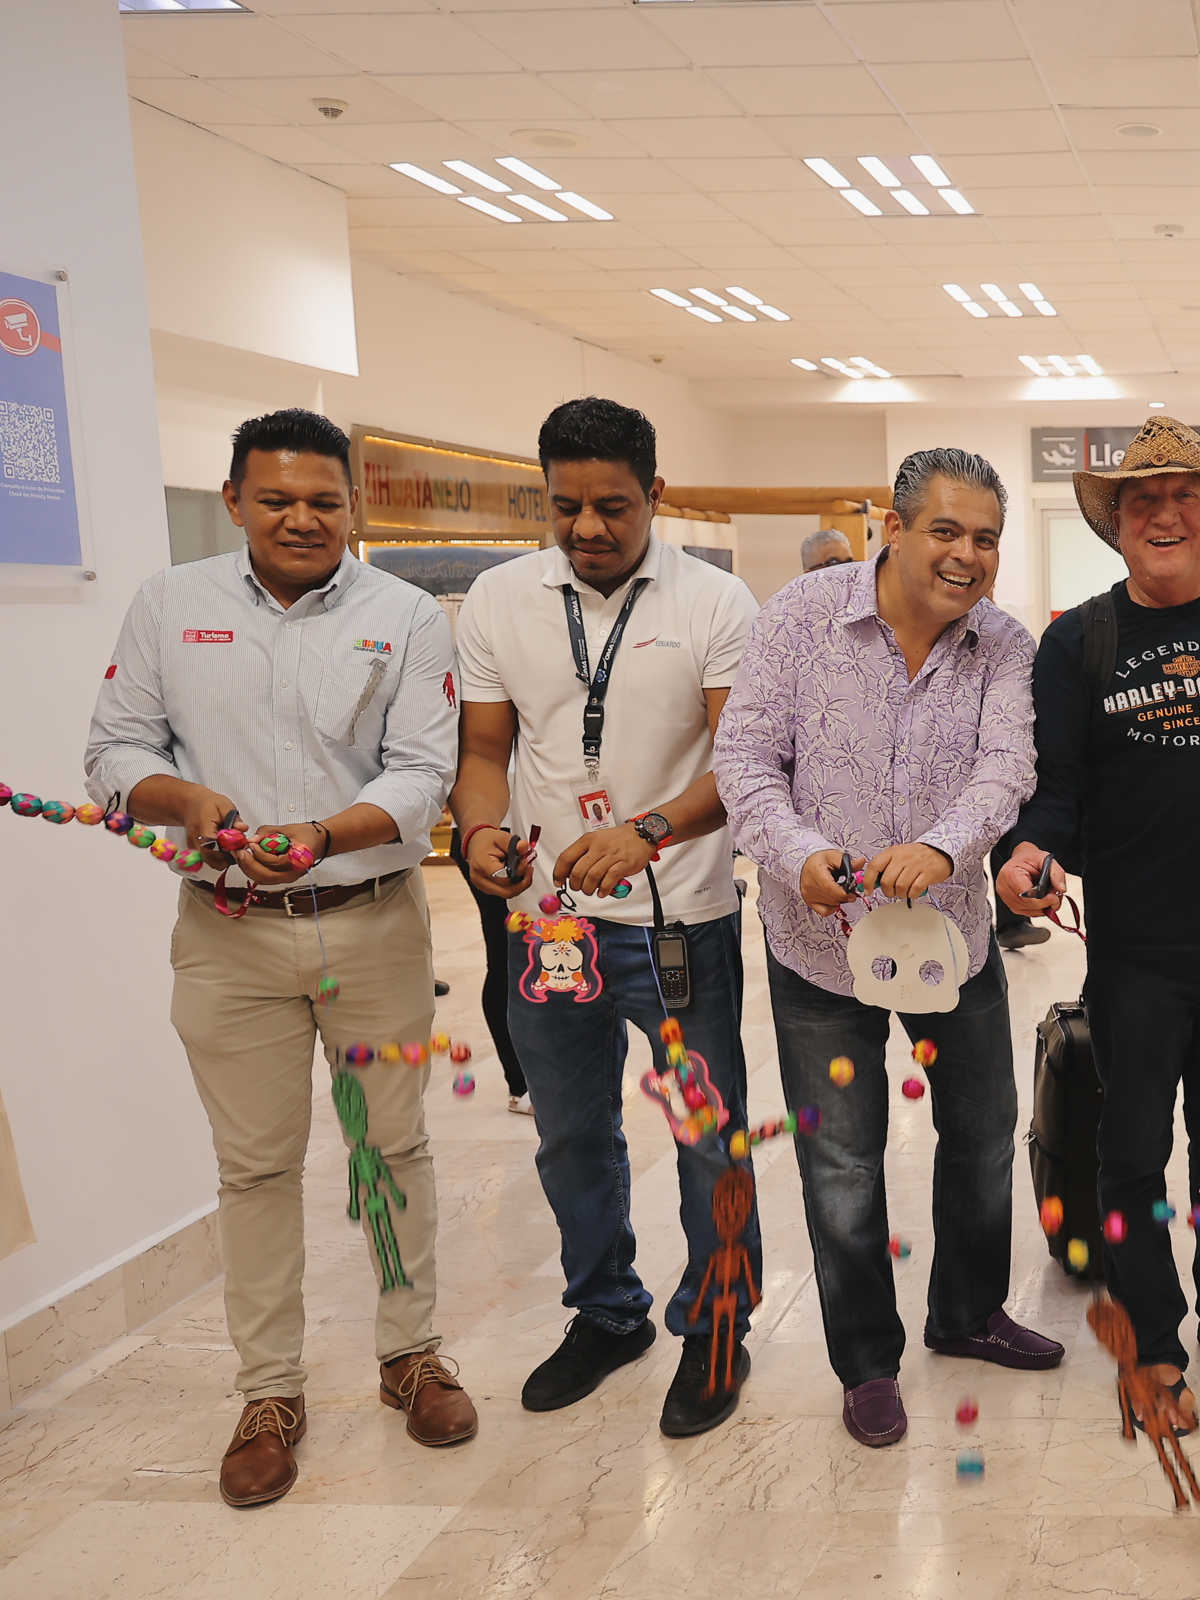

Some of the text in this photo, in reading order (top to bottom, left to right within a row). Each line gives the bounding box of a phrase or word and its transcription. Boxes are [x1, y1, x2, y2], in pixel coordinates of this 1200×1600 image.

[1090, 442, 1126, 467] Lle
[507, 484, 547, 522] HOTEL
[572, 600, 581, 617] OMA
[200, 631, 230, 639] Turismo
[354, 639, 392, 652] ZIHUA
[605, 644, 615, 661] OMA
[655, 640, 681, 649] EDUARDO
[1137, 704, 1194, 722] GENUINE
